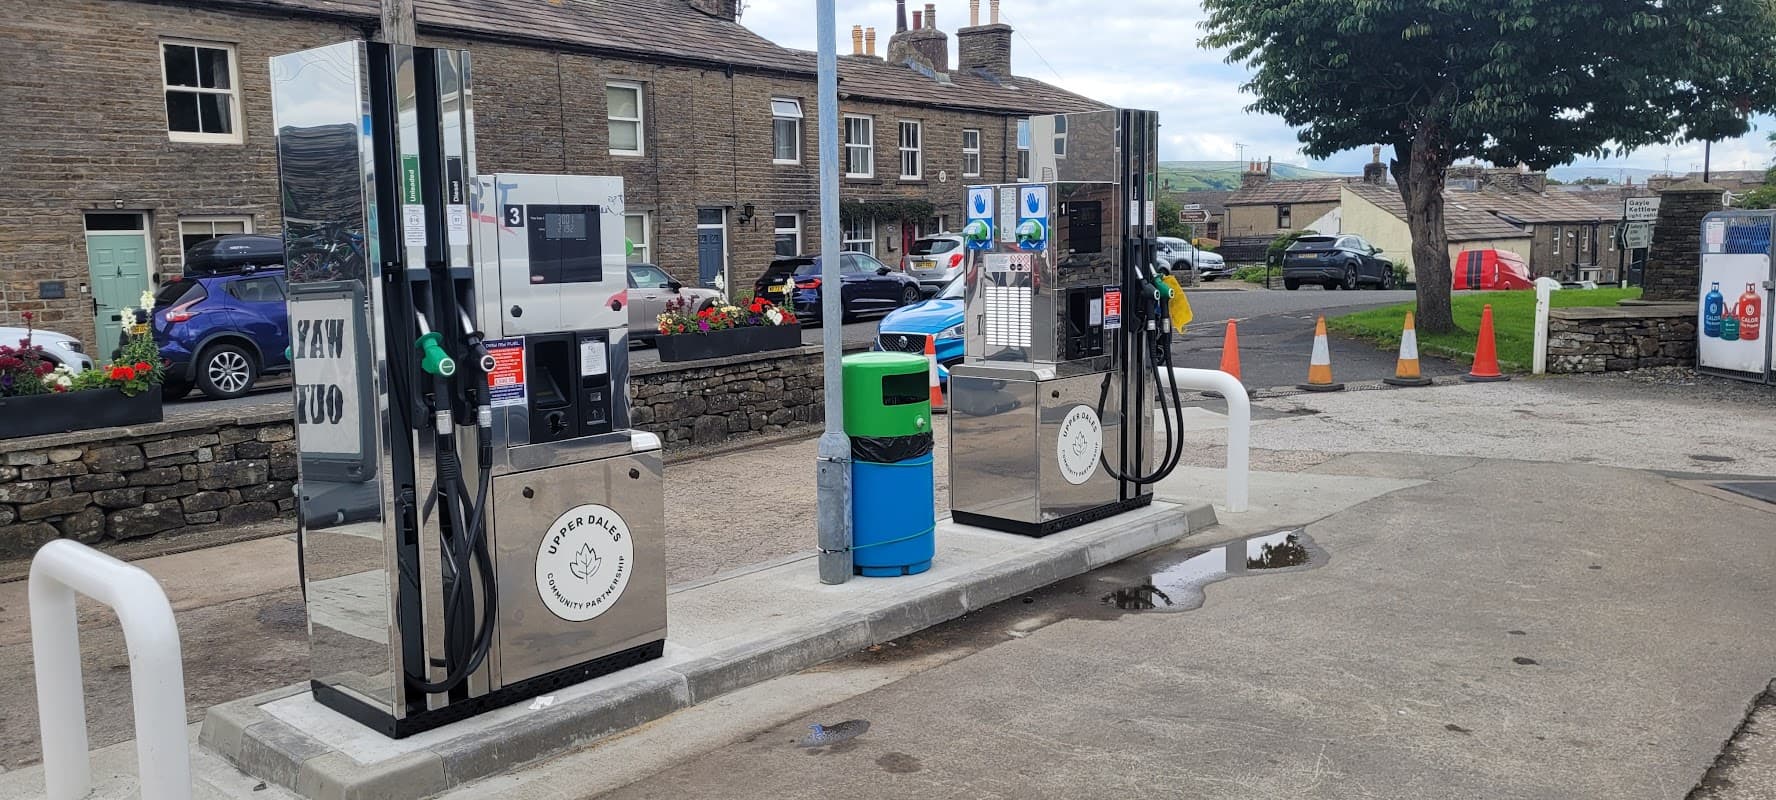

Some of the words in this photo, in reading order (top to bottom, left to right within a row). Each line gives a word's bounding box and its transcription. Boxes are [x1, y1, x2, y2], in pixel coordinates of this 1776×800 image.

[408, 169, 416, 202] Unleaded
[510, 207, 521, 225] 3
[1061, 202, 1066, 215] 1
[1063, 413, 1080, 437] UPPER
[1082, 412, 1098, 433] DALES
[548, 517, 584, 555] UPPER
[588, 515, 621, 542] DALES
[547, 572, 583, 609] COMMUNITY
[586, 555, 625, 608] PARTNERSHIP
